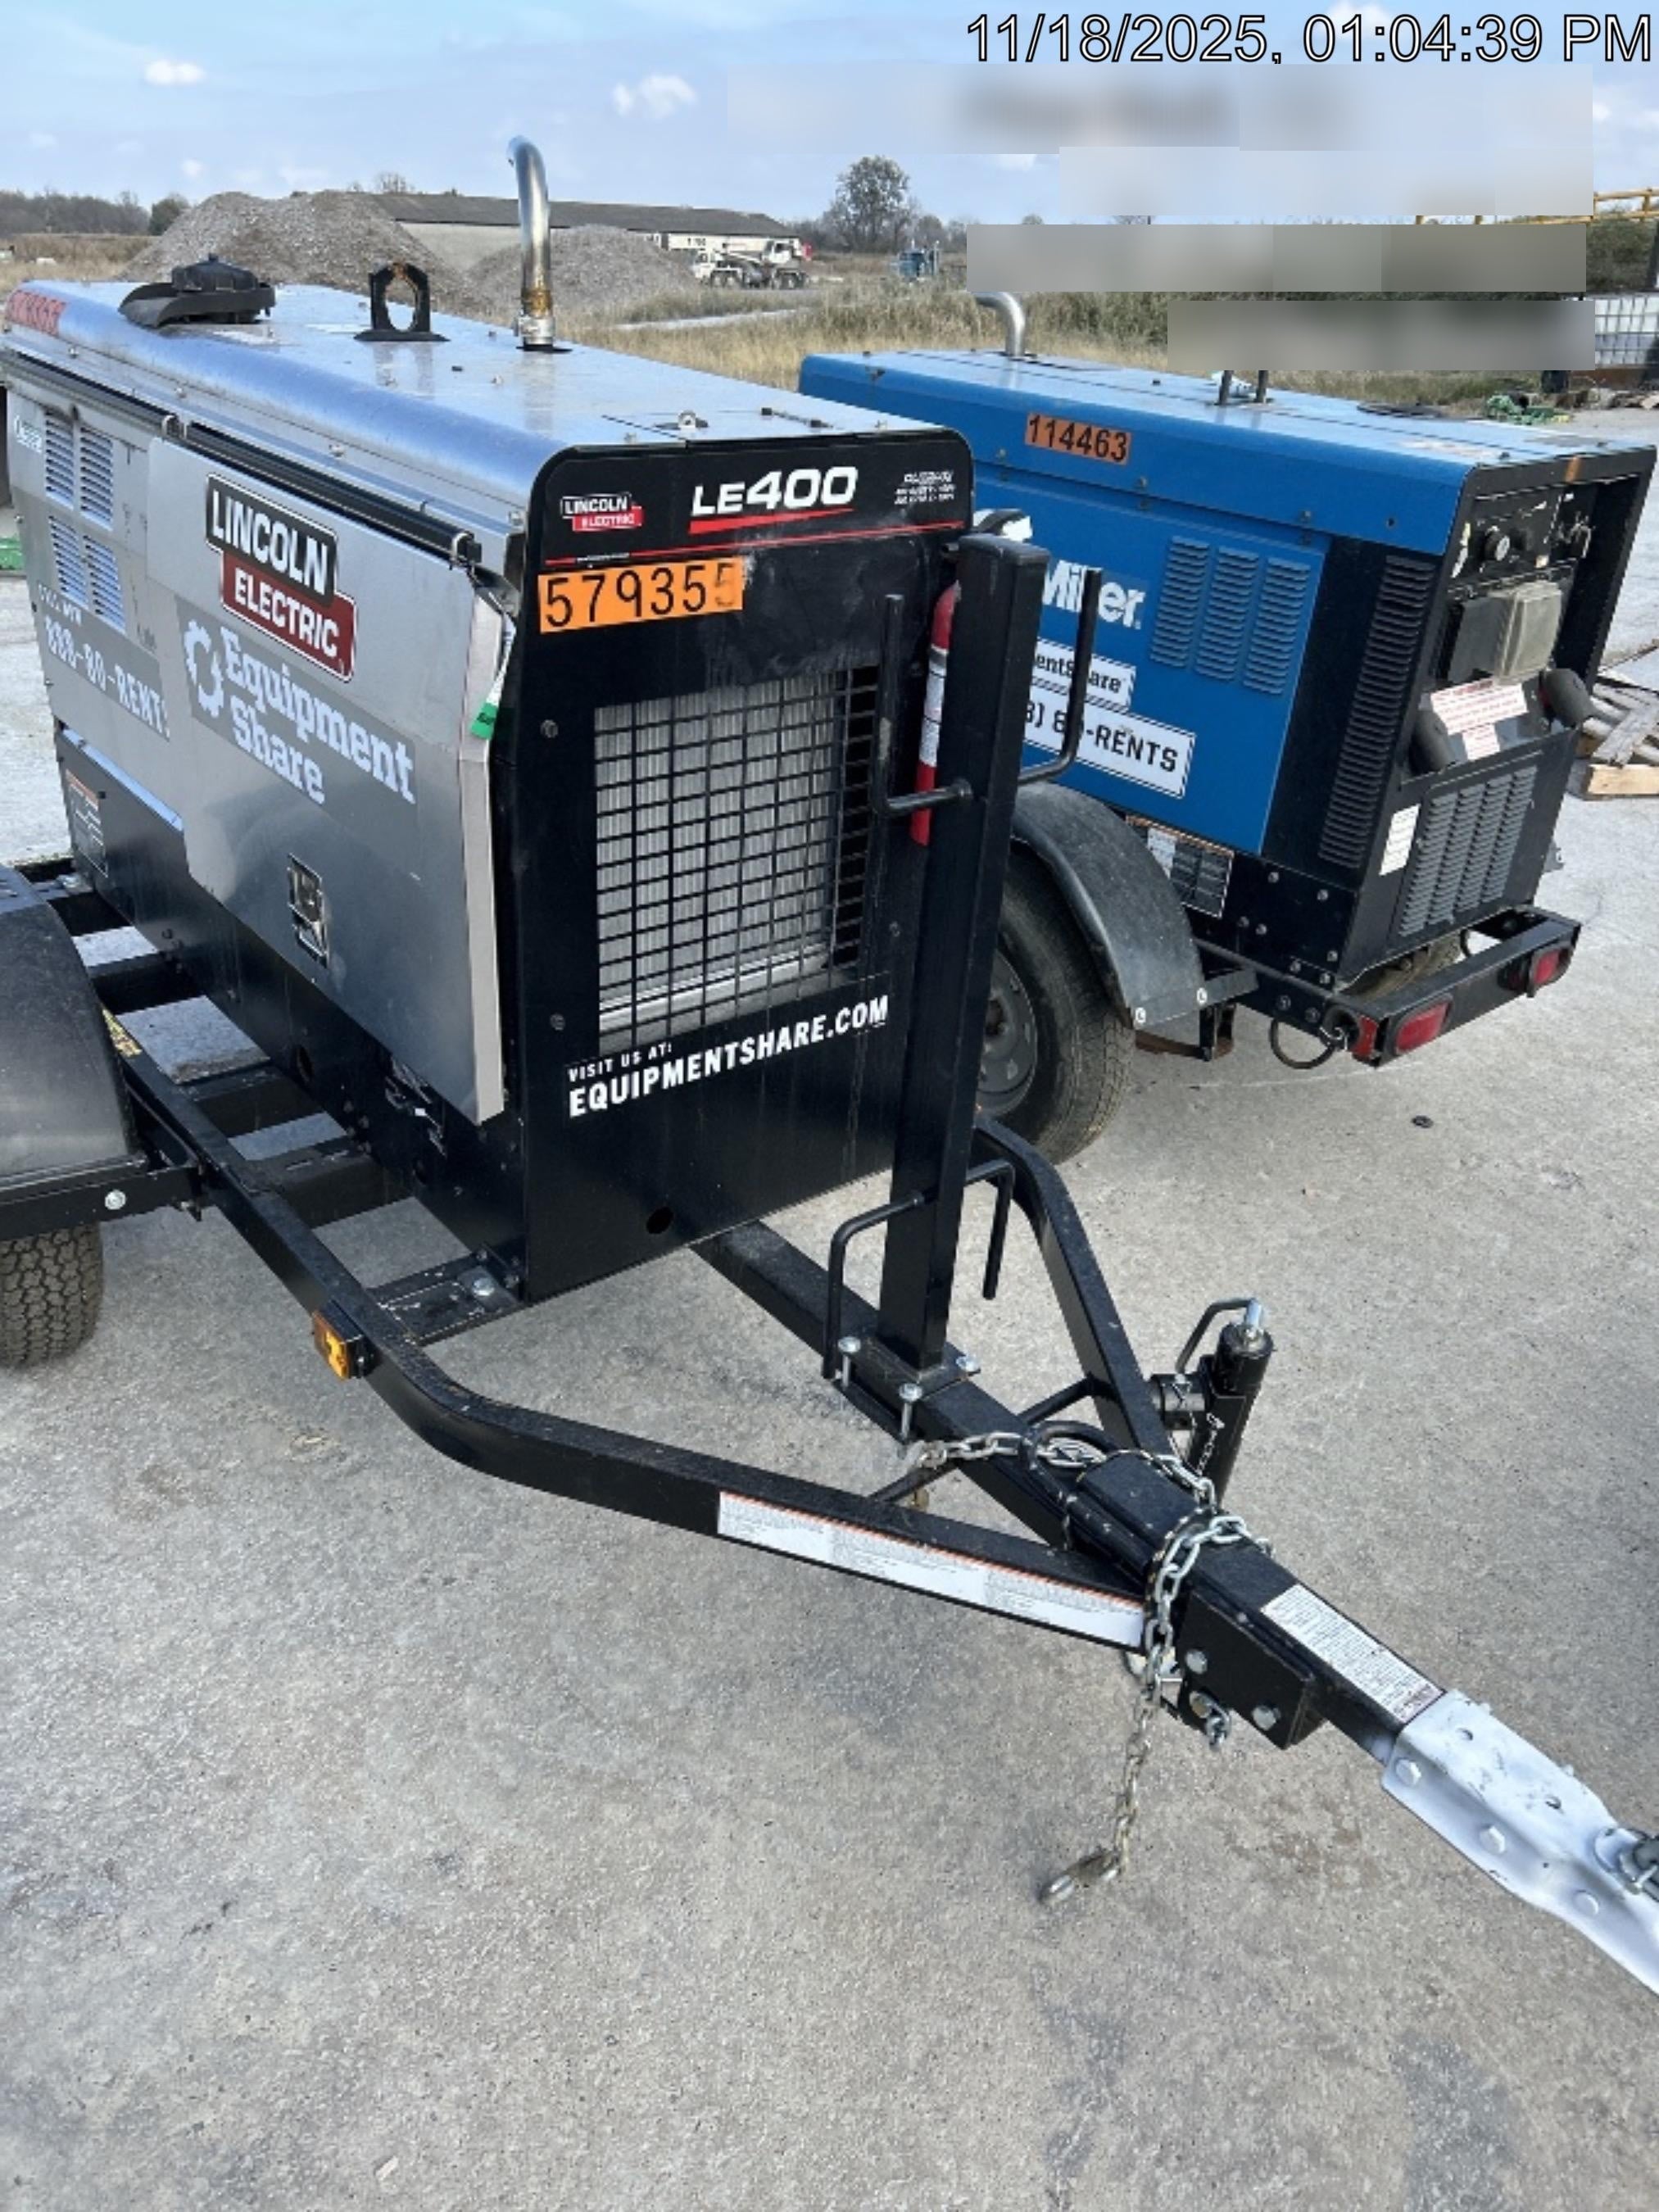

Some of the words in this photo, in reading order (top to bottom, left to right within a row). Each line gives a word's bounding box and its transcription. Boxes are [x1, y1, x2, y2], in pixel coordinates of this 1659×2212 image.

[1030, 415, 1126, 463] 114463
[564, 496, 628, 514] LINCOLN
[691, 466, 859, 517] LE400
[212, 490, 328, 596] LINCOLN
[234, 567, 340, 658] ELECTRIC
[546, 562, 736, 627] 579355
[1041, 560, 1146, 628] Miler
[220, 625, 416, 805] Equipment
[230, 695, 325, 805] Share
[568, 1058, 614, 1082] VISIT
[620, 1050, 641, 1067] US
[648, 1041, 672, 1061] AT:
[569, 995, 889, 1117] EQUIPMENTSHARE.COM
